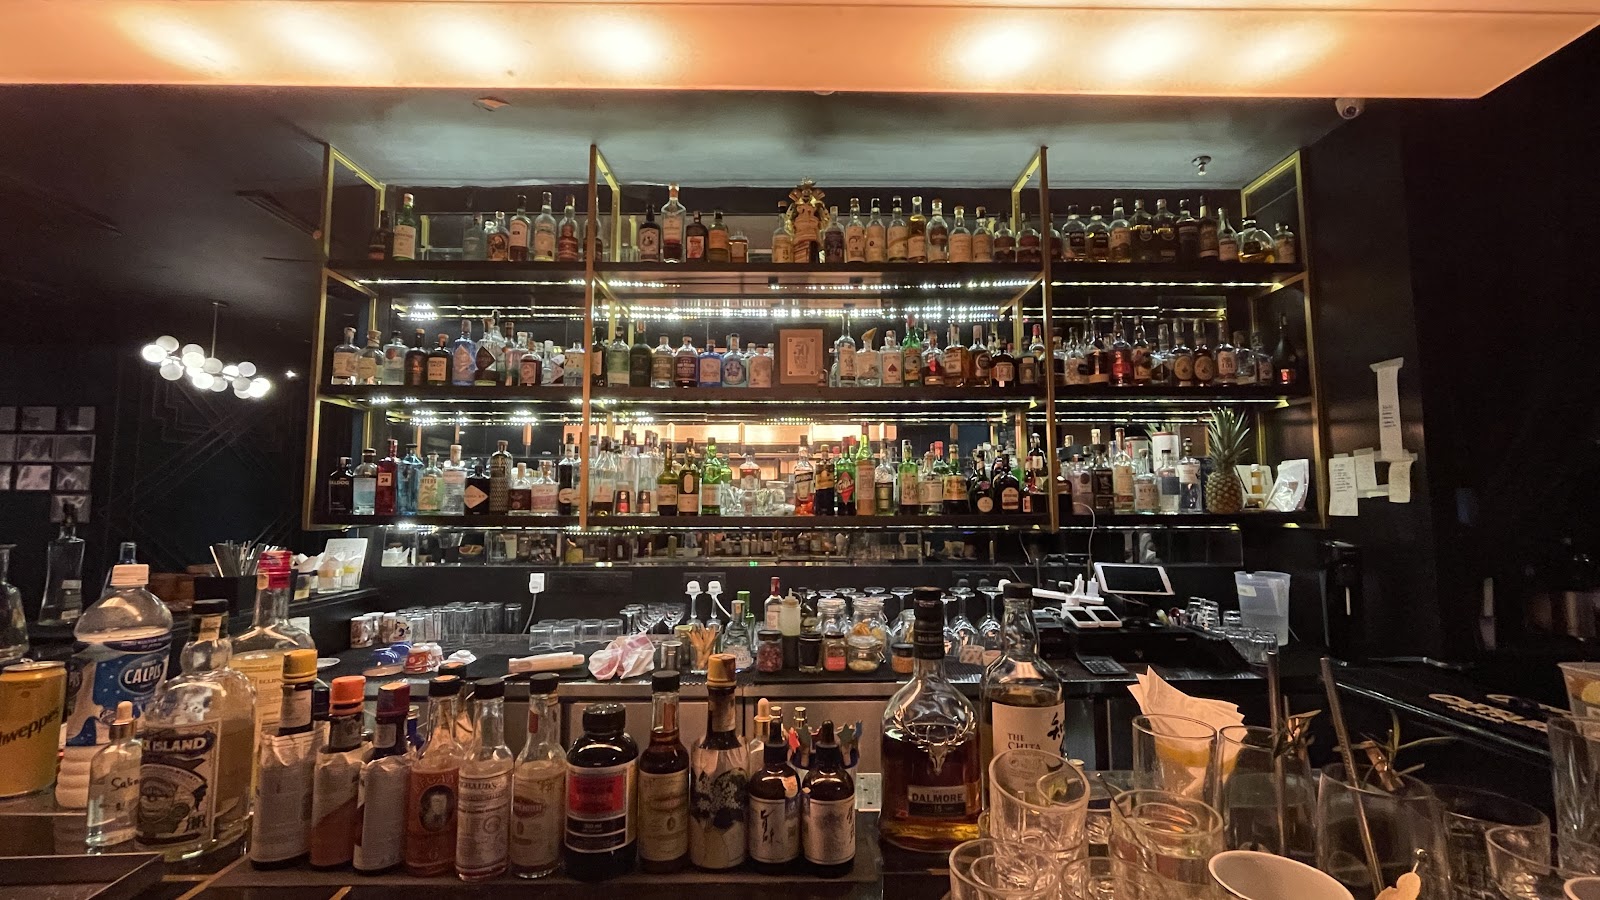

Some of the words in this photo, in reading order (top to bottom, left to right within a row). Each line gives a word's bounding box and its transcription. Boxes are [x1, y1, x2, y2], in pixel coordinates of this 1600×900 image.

[1008, 732, 1025, 742] THE
[152, 738, 207, 751] ISLAND
[911, 793, 965, 803] DALMORE
